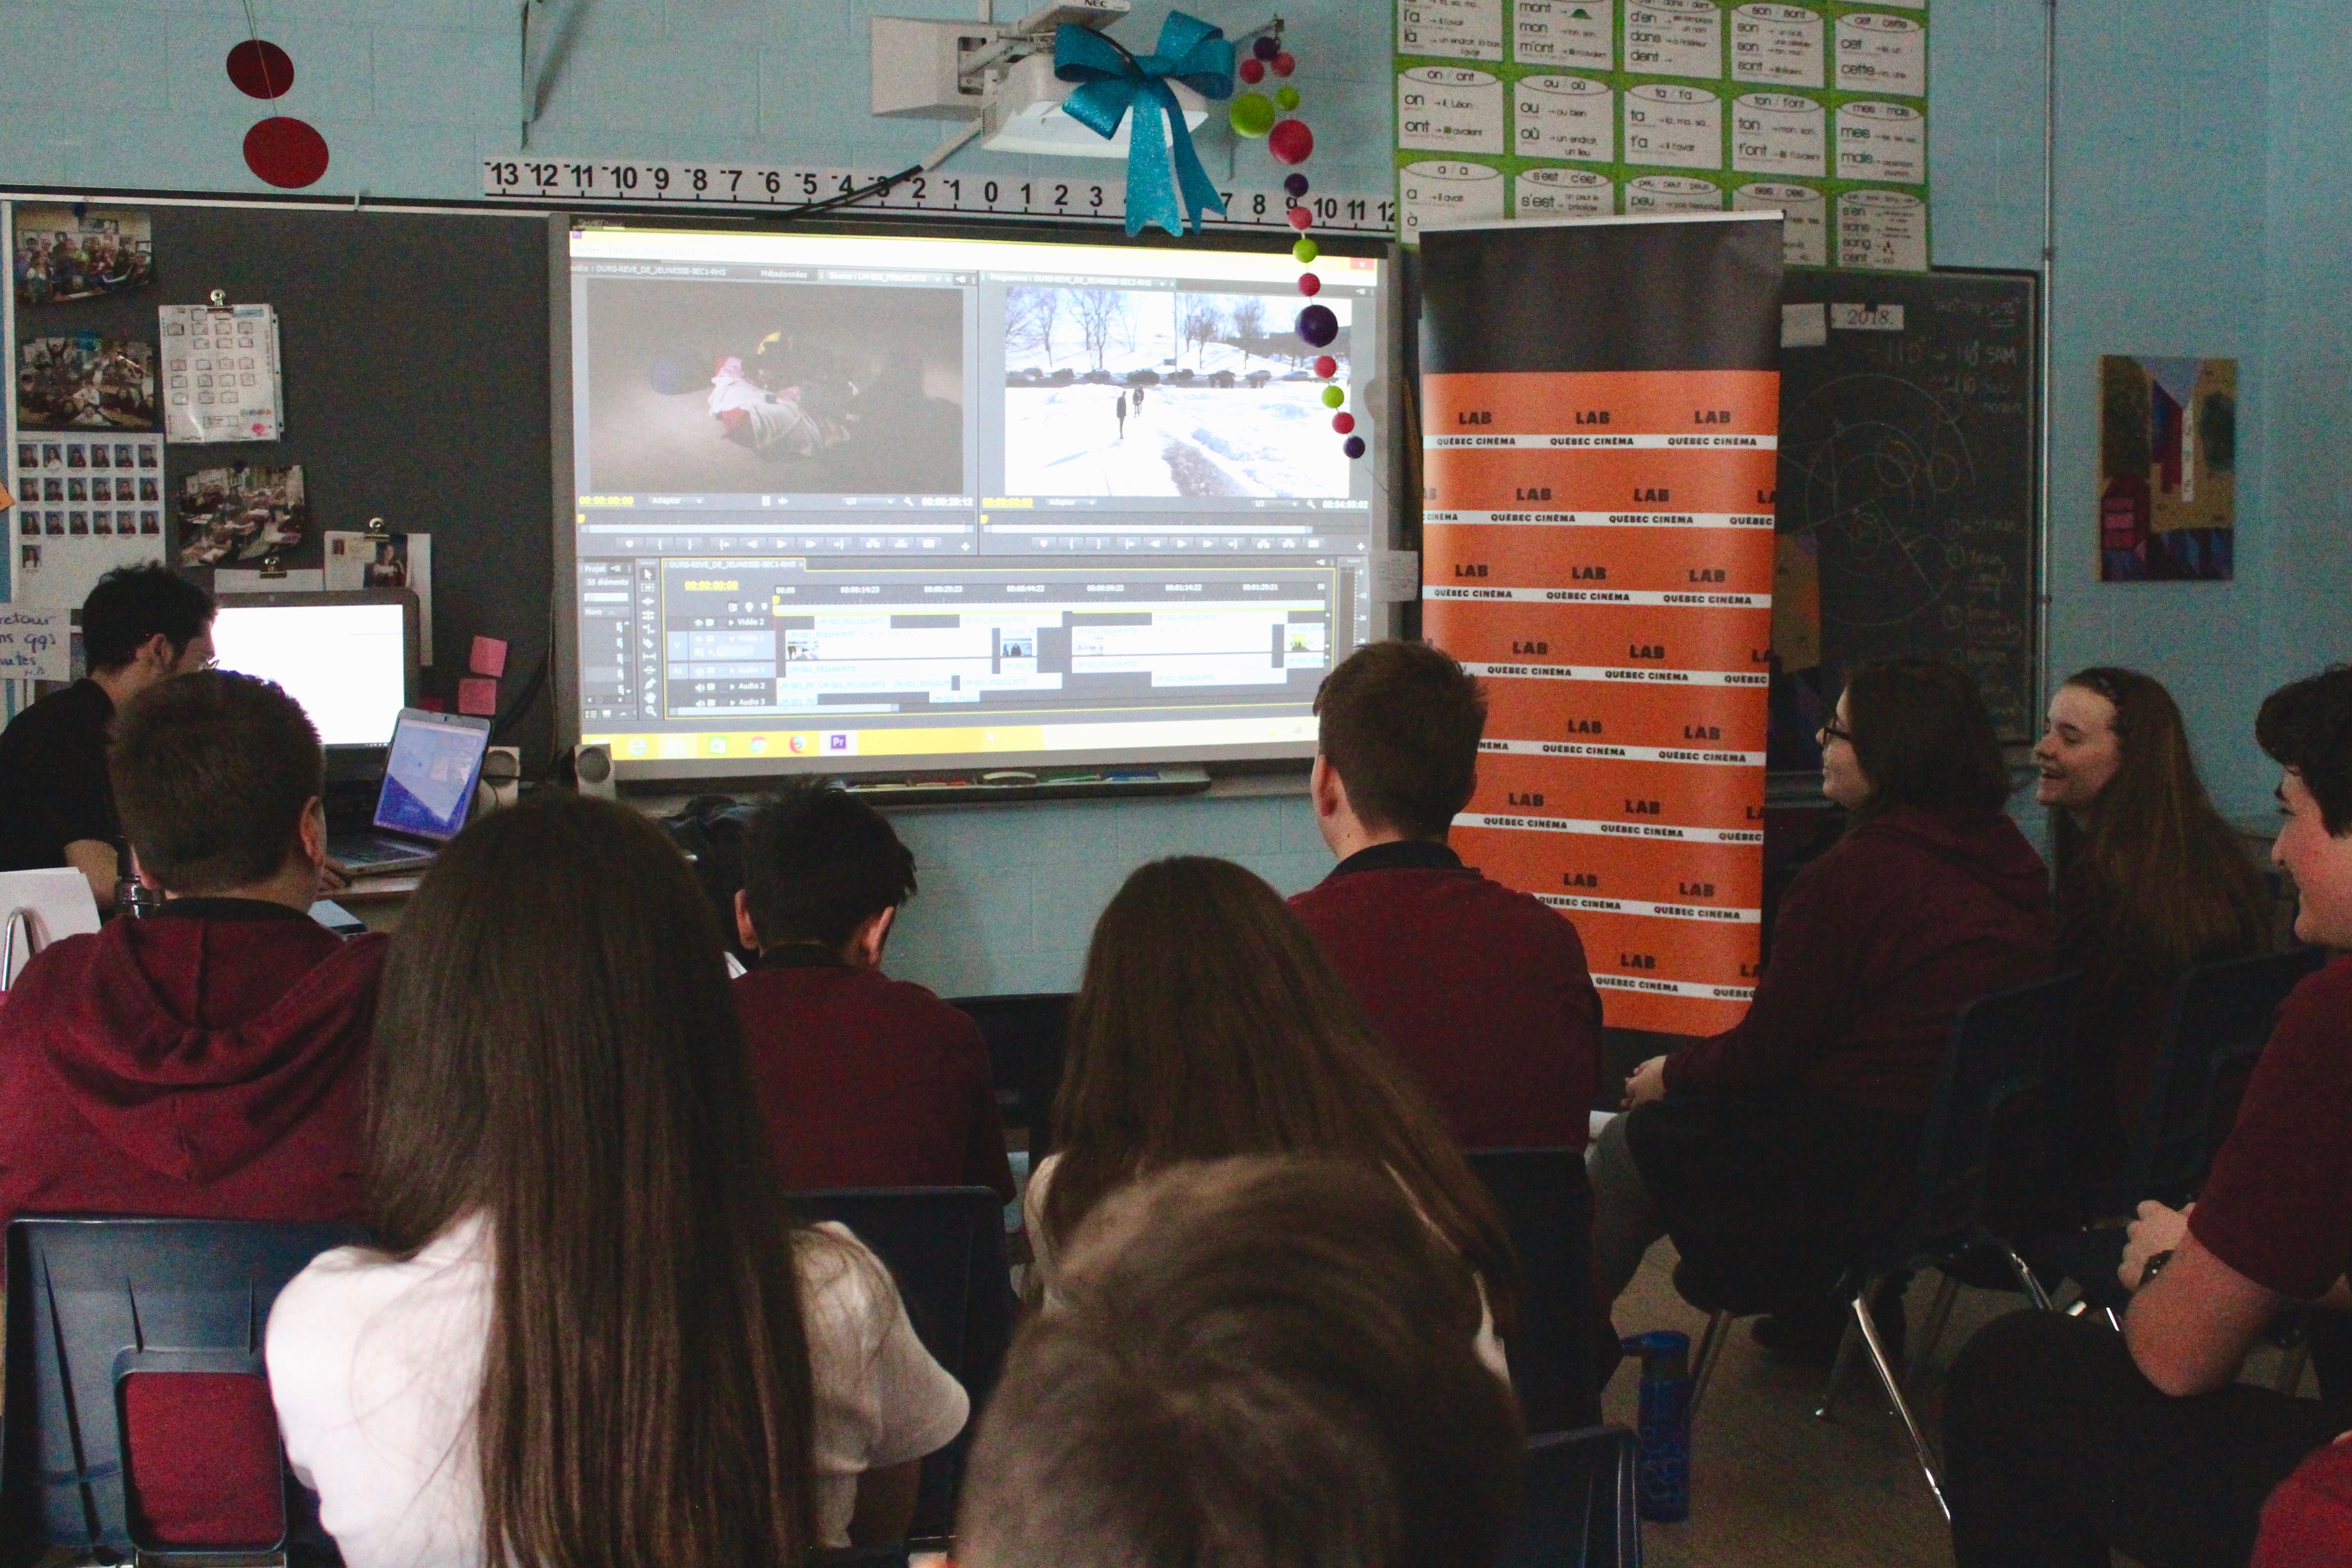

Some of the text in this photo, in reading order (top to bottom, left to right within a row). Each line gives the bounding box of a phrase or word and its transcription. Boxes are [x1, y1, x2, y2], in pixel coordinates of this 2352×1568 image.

[485, 162, 519, 184] -13
[525, 163, 558, 186] -12
[564, 164, 593, 187] -11
[602, 167, 637, 188] -10
[647, 168, 669, 190] -9
[685, 169, 707, 191] -8
[721, 170, 742, 192] -7
[759, 171, 780, 193] -6
[795, 173, 817, 195] -5
[944, 180, 959, 200] -1
[985, 182, 998, 202] 0
[1021, 184, 1030, 204] 1
[1055, 185, 1068, 205] 2
[1090, 186, 1102, 207] 3
[1221, 193, 1233, 212] 7
[1253, 194, 1265, 213] 8
[1314, 199, 1337, 218] 10
[1348, 201, 1365, 220] 11
[1459, 412, 1491, 424] LAB
[1576, 412, 1610, 424] LAB
[1695, 411, 1730, 424] LAB
[652, 497, 681, 505] Adapter
[1517, 488, 1550, 501] LAB
[1634, 489, 1668, 502] LAB
[1455, 565, 1488, 577] LAB
[1572, 566, 1606, 579] LAB
[1690, 569, 1725, 582] LAB
[1513, 642, 1547, 654] LAB
[1630, 646, 1664, 658] LAB
[1568, 720, 1601, 733] LAB
[1685, 726, 1719, 739] LAB
[832, 737, 844, 747] Pr
[1509, 793, 1543, 806] LAB
[1625, 800, 1660, 813] LAB
[1564, 874, 1597, 887] LAB
[1680, 883, 1714, 896] LAB
[1621, 954, 1655, 968] LAB
